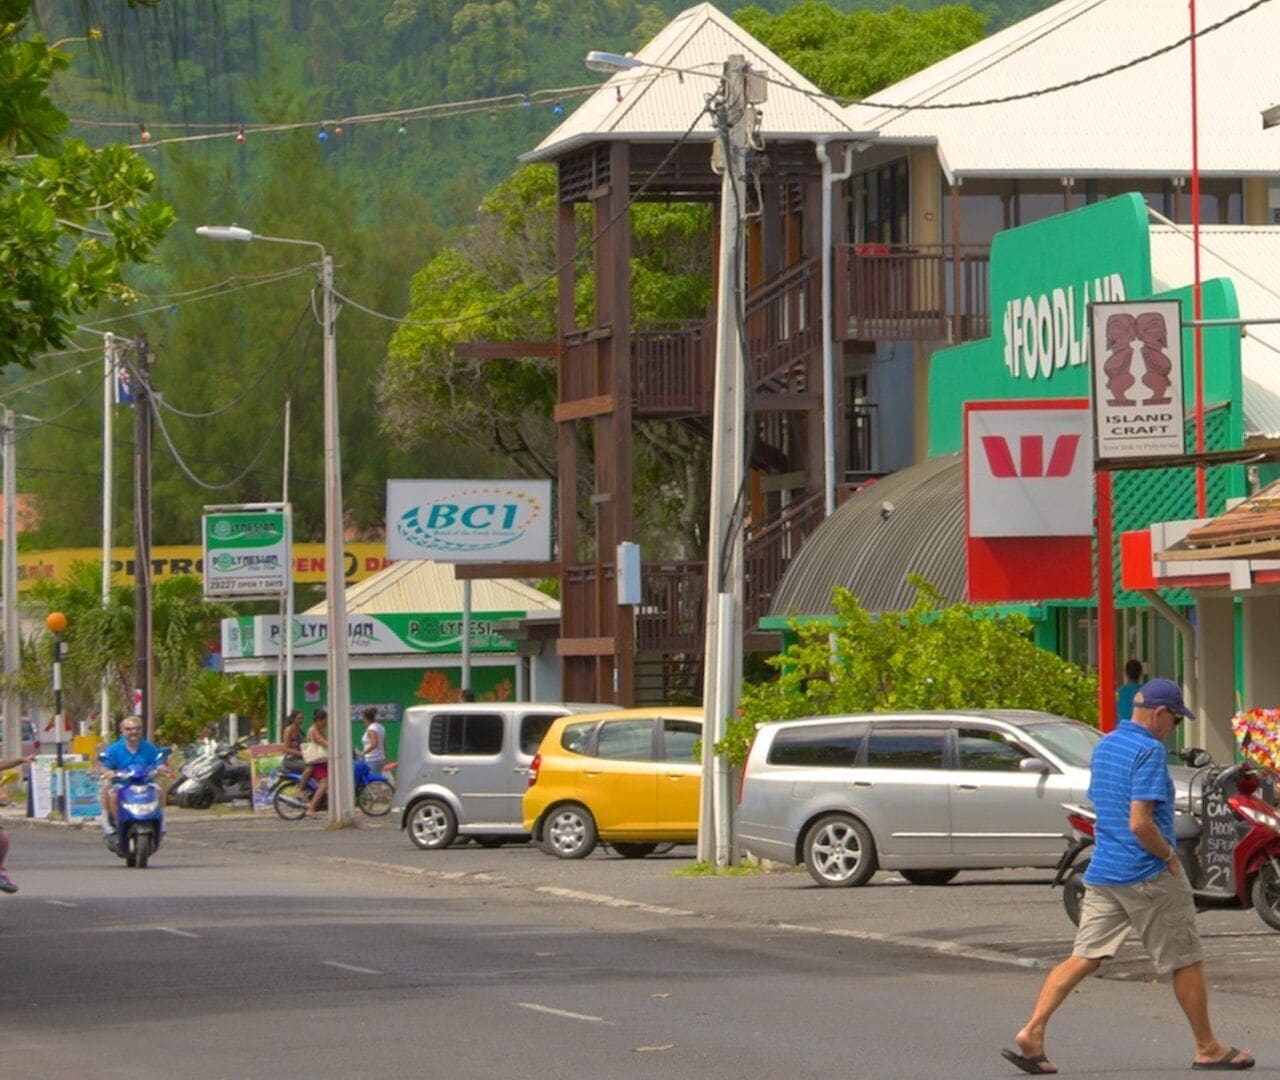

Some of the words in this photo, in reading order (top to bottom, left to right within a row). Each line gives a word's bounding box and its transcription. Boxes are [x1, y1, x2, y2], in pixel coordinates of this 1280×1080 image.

[1105, 413, 1173, 424] ISLAND
[1111, 425, 1168, 435] CRAFT
[427, 504, 518, 529] BCI
